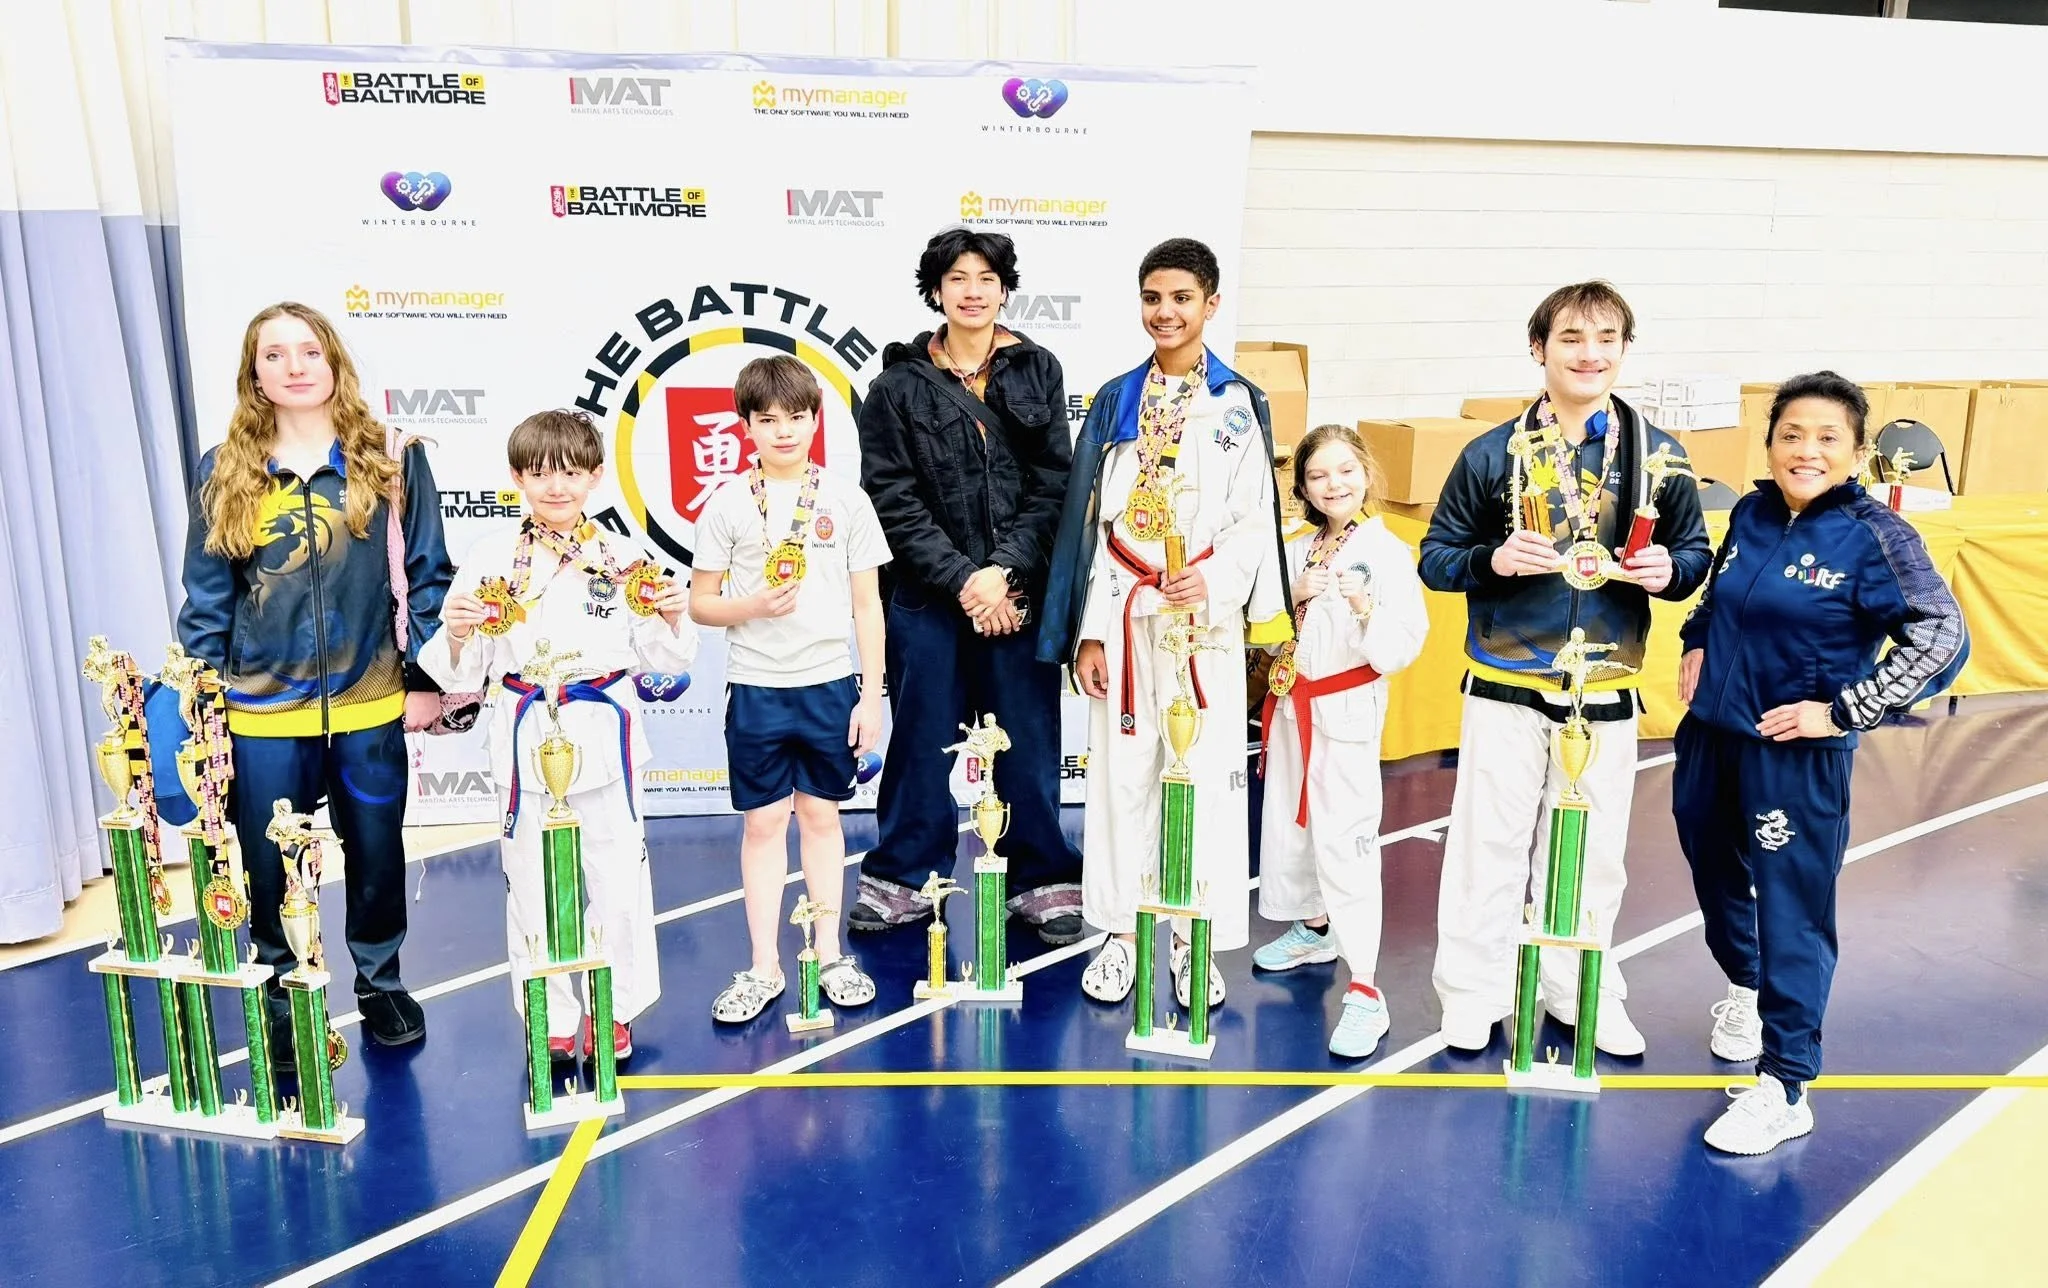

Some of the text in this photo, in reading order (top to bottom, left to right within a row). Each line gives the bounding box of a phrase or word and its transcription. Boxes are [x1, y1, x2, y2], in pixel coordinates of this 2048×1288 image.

[353, 72, 479, 88] BATTLE OF
[341, 89, 486, 104] BALTIMORE
[569, 77, 671, 106] MAT
[782, 87, 907, 107] mymanager
[791, 109, 830, 117] SOFTWARE
[833, 110, 848, 118] YOU
[981, 125, 1087, 135] WINTERBOURNE
[580, 186, 681, 202] BATTLE
[687, 191, 700, 200] OF
[568, 202, 706, 217] BALTIMORE
[787, 189, 883, 217] MAT
[989, 198, 1108, 216] mymanager
[376, 291, 504, 309] mymanager
[575, 282, 878, 417] HE BATTLE
[385, 389, 485, 415] MAT
[437, 491, 496, 504] TTLE
[440, 505, 521, 518] IMORE
[643, 769, 728, 783] manage
